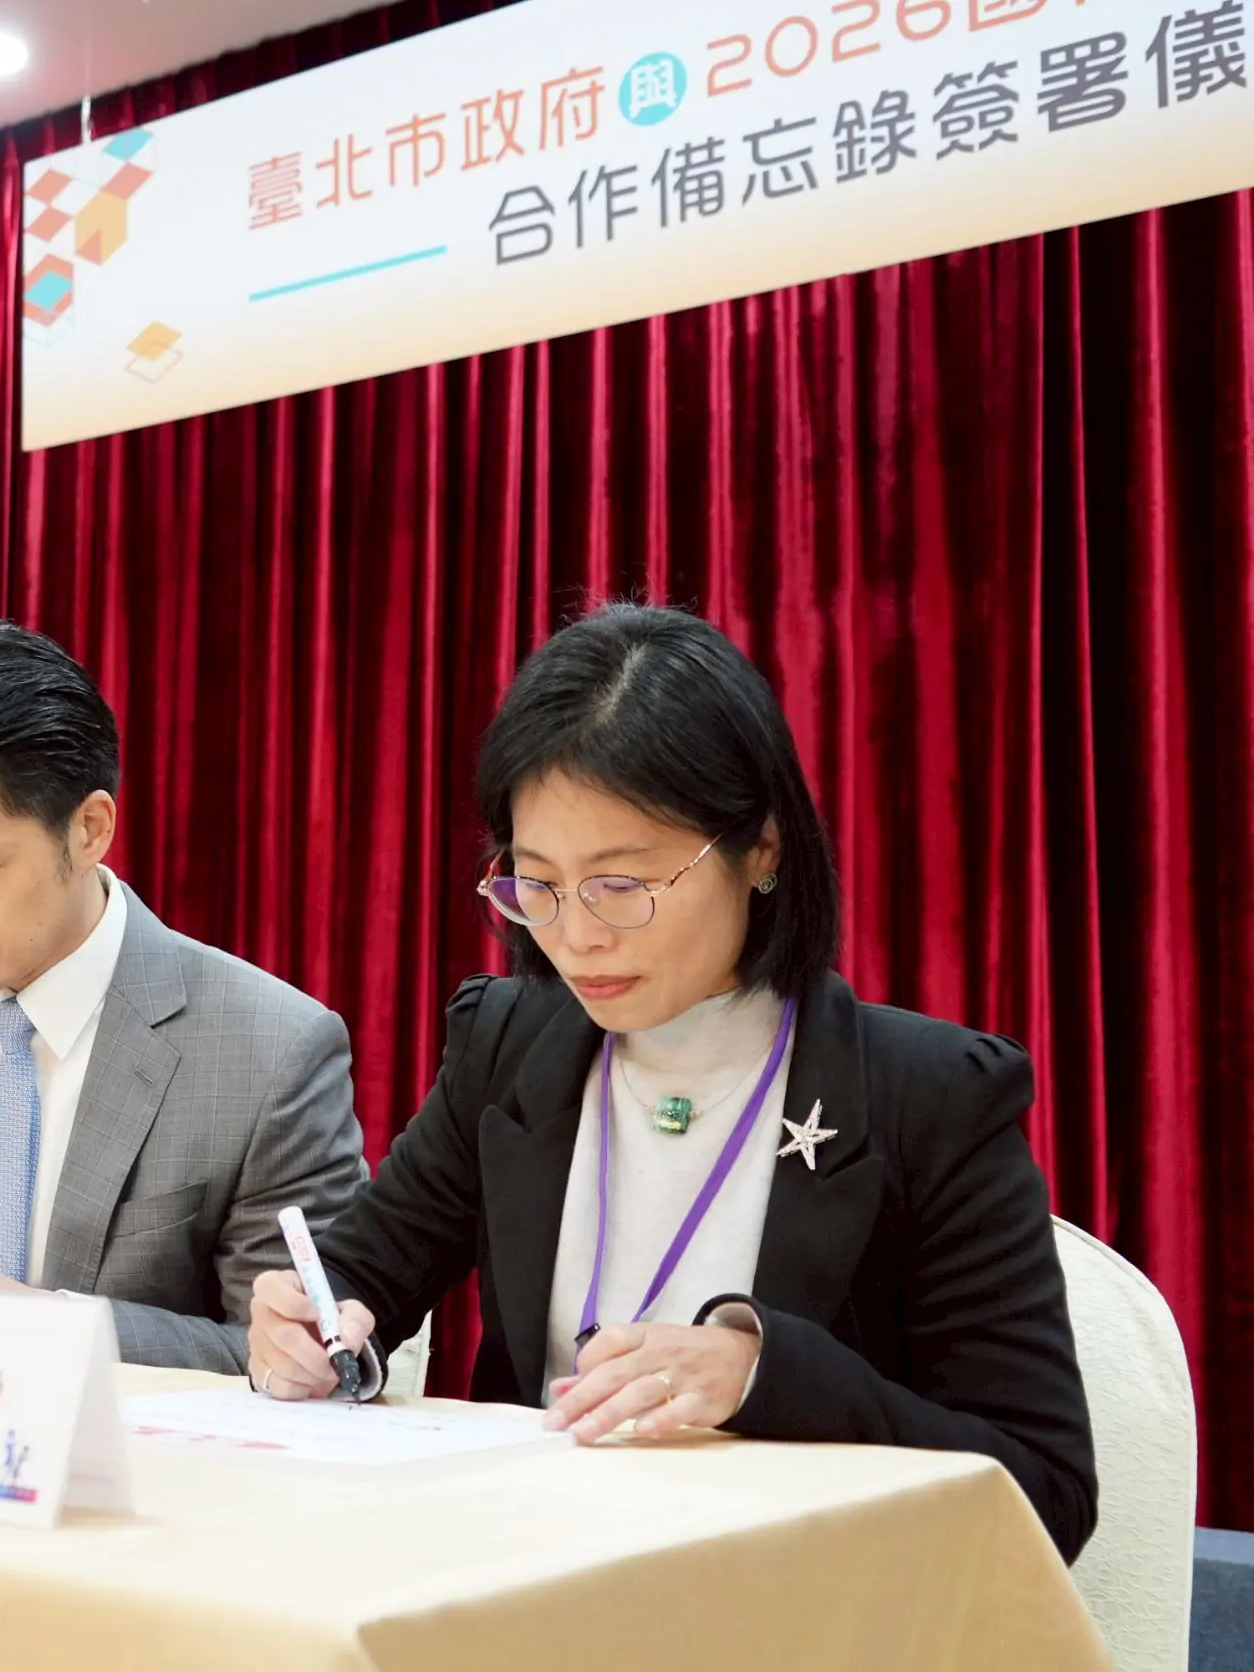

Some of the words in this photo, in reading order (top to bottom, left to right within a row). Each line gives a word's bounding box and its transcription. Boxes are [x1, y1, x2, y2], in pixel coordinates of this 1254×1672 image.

[489, 0, 1248, 266] 合作備忘錄簽署儀
